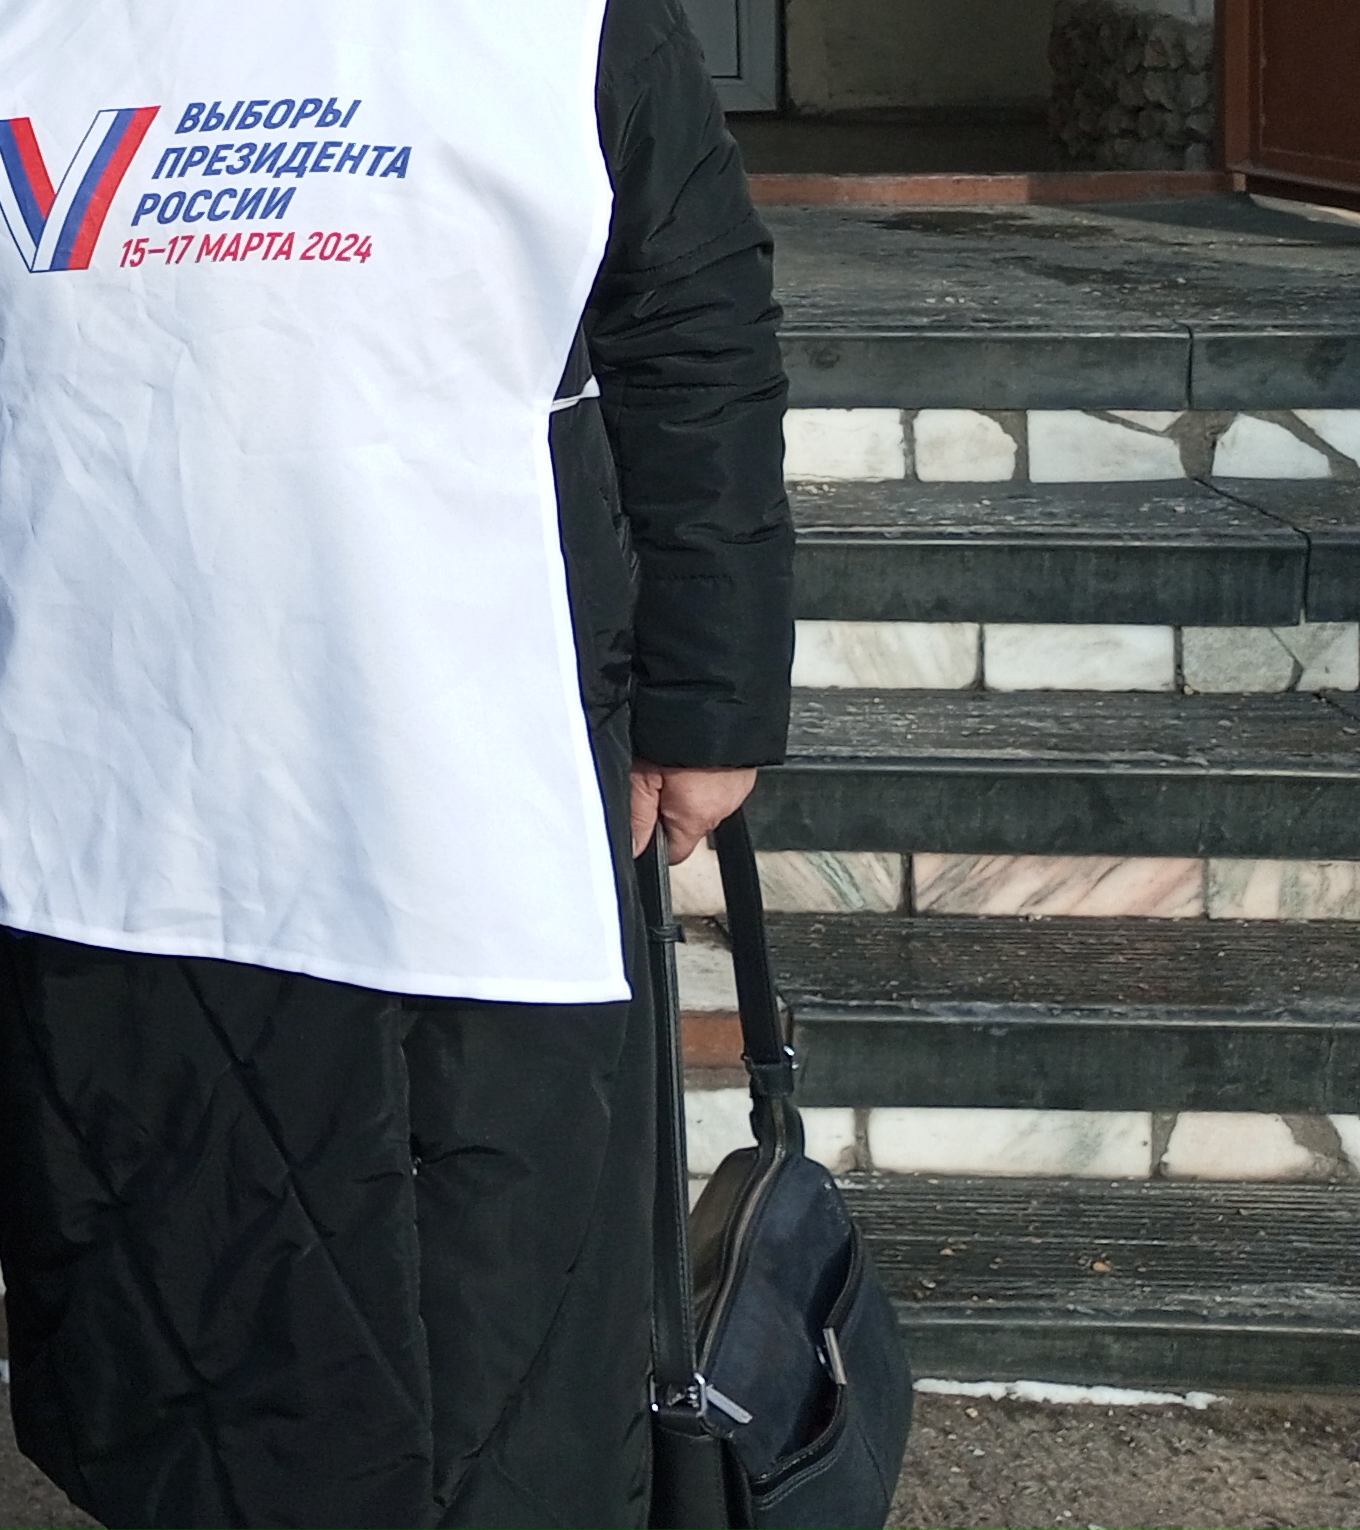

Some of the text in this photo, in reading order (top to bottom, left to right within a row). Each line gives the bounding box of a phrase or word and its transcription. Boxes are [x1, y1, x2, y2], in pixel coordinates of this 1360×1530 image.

[175, 97, 362, 134] ВЫБОРЫ
[151, 141, 413, 180] ПРЕЗИДЕНТА
[130, 186, 297, 227] РОССИИ
[194, 231, 296, 264] МАРТА
[298, 231, 373, 264] 2024
